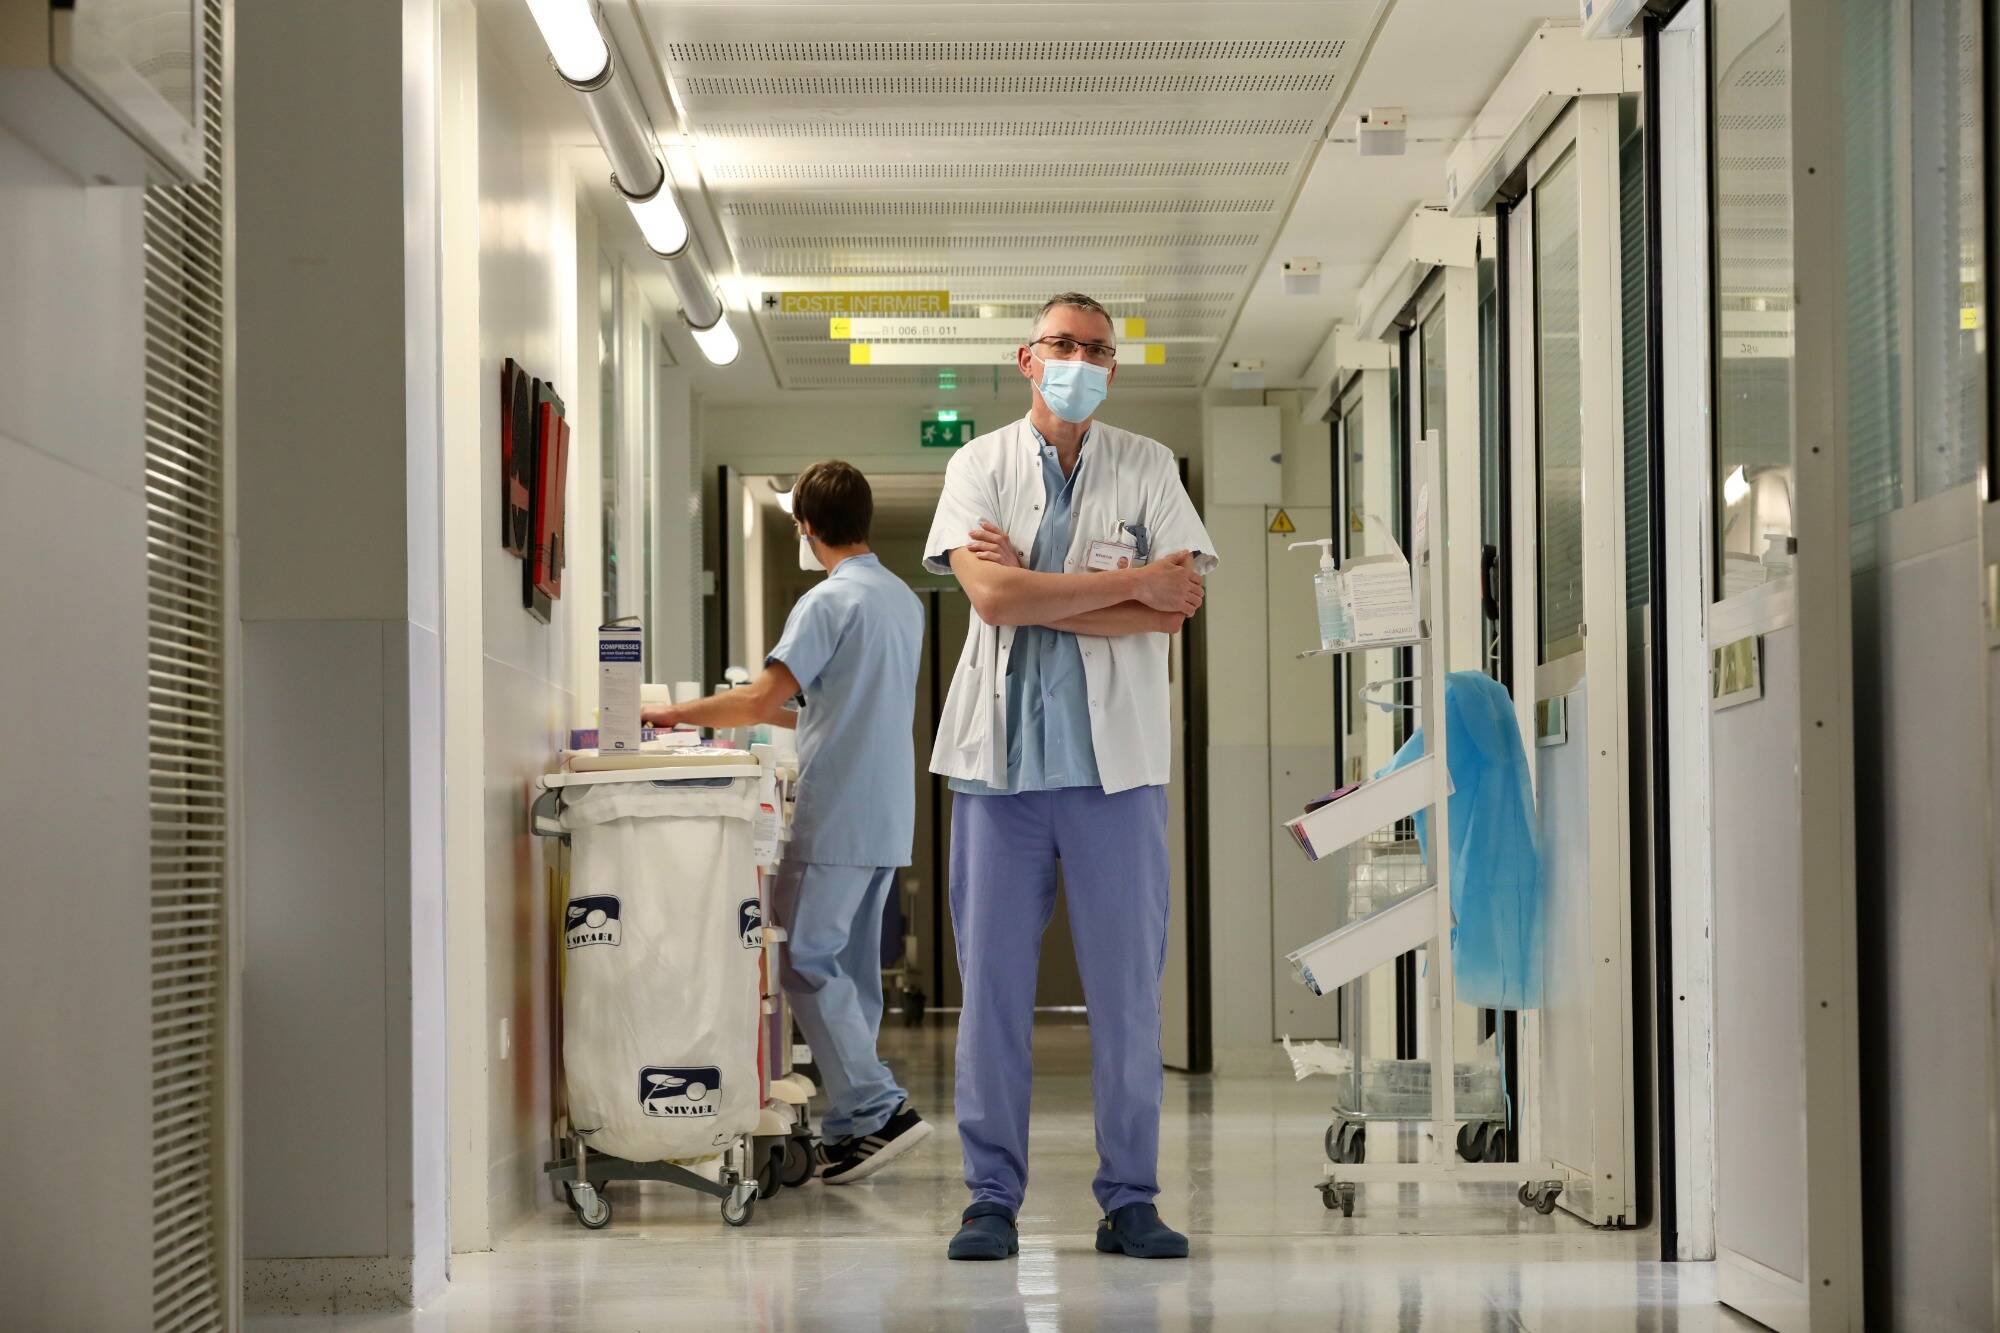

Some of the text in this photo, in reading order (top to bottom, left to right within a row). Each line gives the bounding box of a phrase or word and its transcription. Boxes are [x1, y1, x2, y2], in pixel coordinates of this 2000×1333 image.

[785, 295, 940, 311] POSTE INFIRMIER
[898, 326, 917, 335] 006
[938, 326, 957, 335] 011
